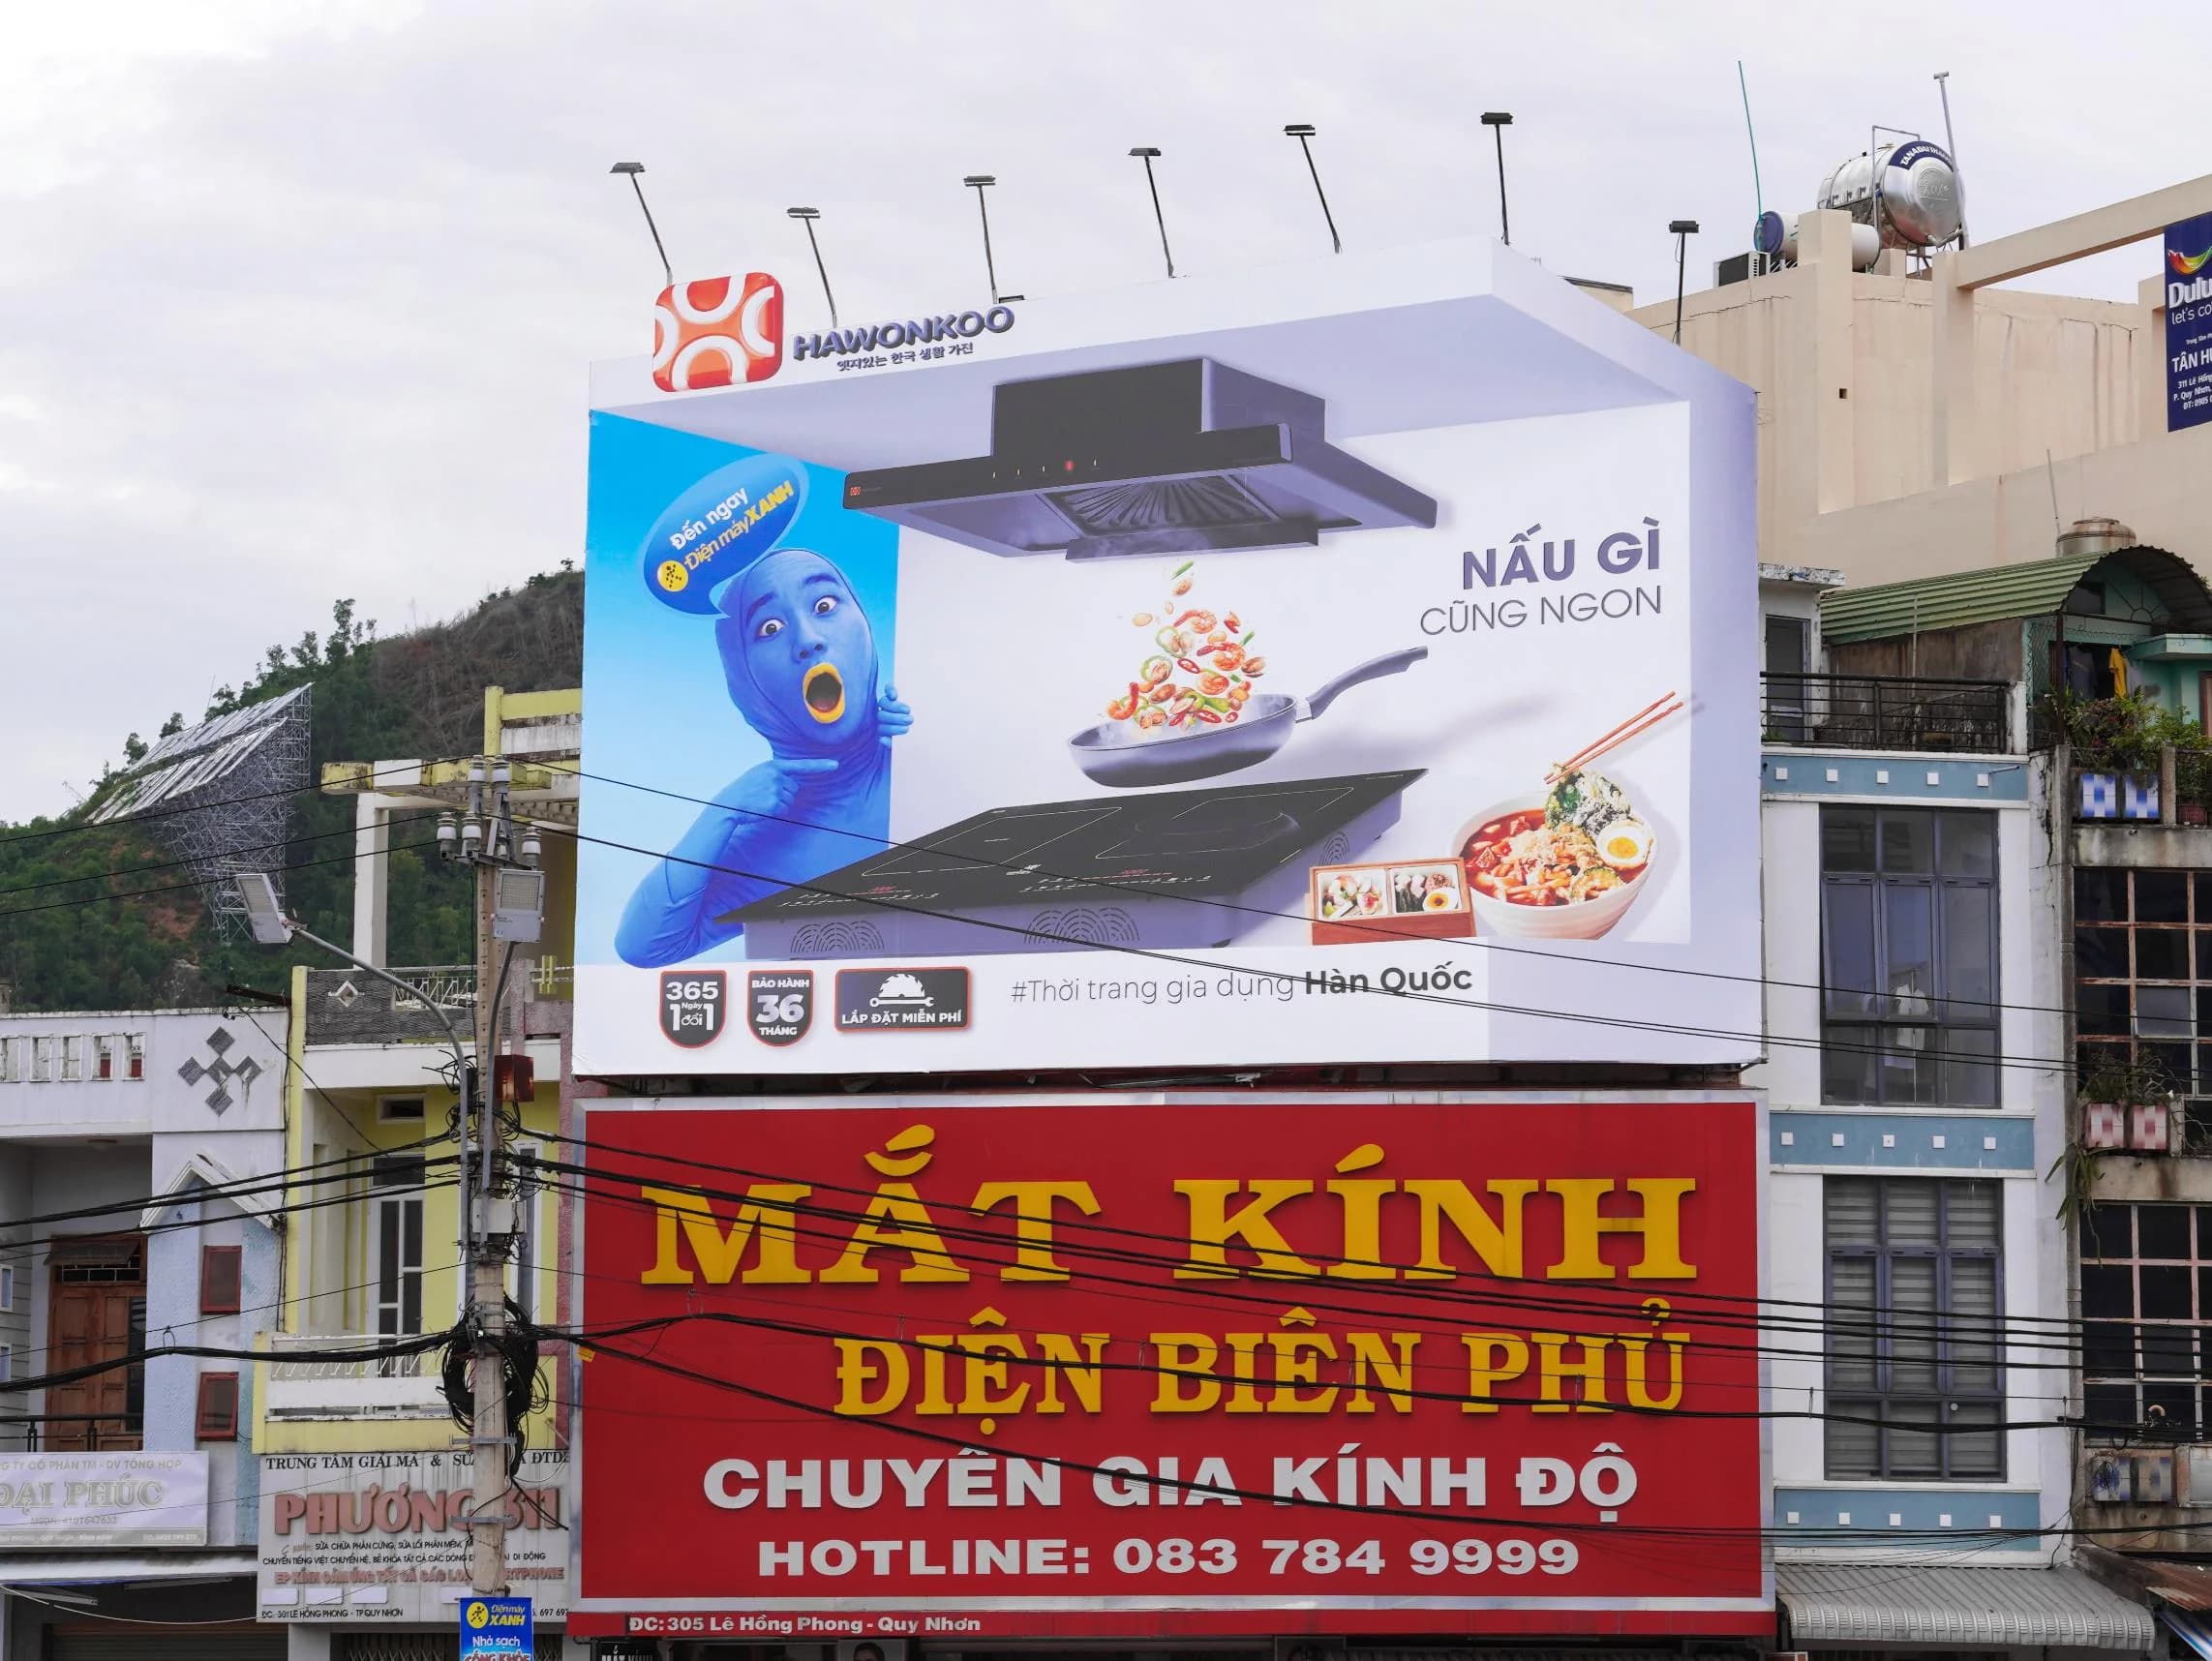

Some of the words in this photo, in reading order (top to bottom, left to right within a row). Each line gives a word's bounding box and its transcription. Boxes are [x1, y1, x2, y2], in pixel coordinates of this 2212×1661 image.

[2171, 307, 2195, 325] let's
[793, 306, 1015, 361] HAWONKOO
[891, 350, 916, 365] 한국
[919, 346, 945, 360] 생활
[2171, 350, 2198, 373] TÂN
[2180, 391, 2193, 400] Quy
[669, 520, 708, 550] Đến
[705, 487, 749, 525] ngay
[684, 539, 719, 570] Điện
[744, 480, 795, 526] XANH
[1463, 523, 1576, 590] NẤU
[1597, 516, 1660, 575] GÌ
[1420, 599, 1528, 636] CŨNG
[1540, 585, 1662, 625] NGON
[665, 981, 719, 1001] 365
[751, 977, 776, 988] BẢO
[777, 977, 810, 988] HÀNH
[1011, 978, 1079, 1003] #Thời
[1087, 980, 1157, 1005] trang
[1167, 974, 1207, 1005] gia
[1217, 971, 1293, 1002] dụng
[1306, 968, 1369, 995] Hàn
[1379, 960, 1472, 997] Quốc
[670, 1003, 682, 1031] 1
[703, 1003, 714, 1031] 1
[682, 1002, 704, 1011] Ngày
[755, 993, 804, 1023] 36
[841, 1009, 868, 1024] LẮP
[871, 1010, 899, 1026] ĐẶT
[901, 1008, 936, 1023] MIỄN
[939, 1009, 962, 1022] PHÍ
[759, 1024, 798, 1036] THÁNG
[641, 1124, 1103, 1285] MẮT
[1172, 1143, 1698, 1281] KÍNH
[833, 1306, 1111, 1436] ĐIỆN
[1148, 1306, 1422, 1415] BIÊN
[1461, 1297, 1690, 1413] PHỦ
[106, 1460, 121, 1469] DV
[266, 1456, 317, 1469] TRUNG
[322, 1453, 353, 1468] TÂM
[431, 1454, 441, 1466] &
[63, 1471, 164, 1509] PHÚC
[703, 1447, 1063, 1509] CHUYÊN
[1091, 1456, 1244, 1508] GIA
[1272, 1442, 1488, 1508] KÍNH
[1515, 1441, 1638, 1524] ĐỘ
[758, 1538, 1090, 1577] HOTLINE:
[1112, 1537, 1239, 1576] 083
[1261, 1538, 1387, 1576] 784
[1409, 1538, 1581, 1576] 9999
[322, 1609, 348, 1617] PHONG
[489, 1615, 527, 1626] XANH
[628, 1616, 665, 1631] ĐC:
[667, 1616, 705, 1631] 305
[710, 1616, 735, 1631] Lê
[740, 1614, 792, 1634] Hồng
[797, 1616, 864, 1634] Phong
[877, 1616, 918, 1634] Quy
[924, 1616, 981, 1632] Nhơn
[495, 1635, 521, 1649] sạch
